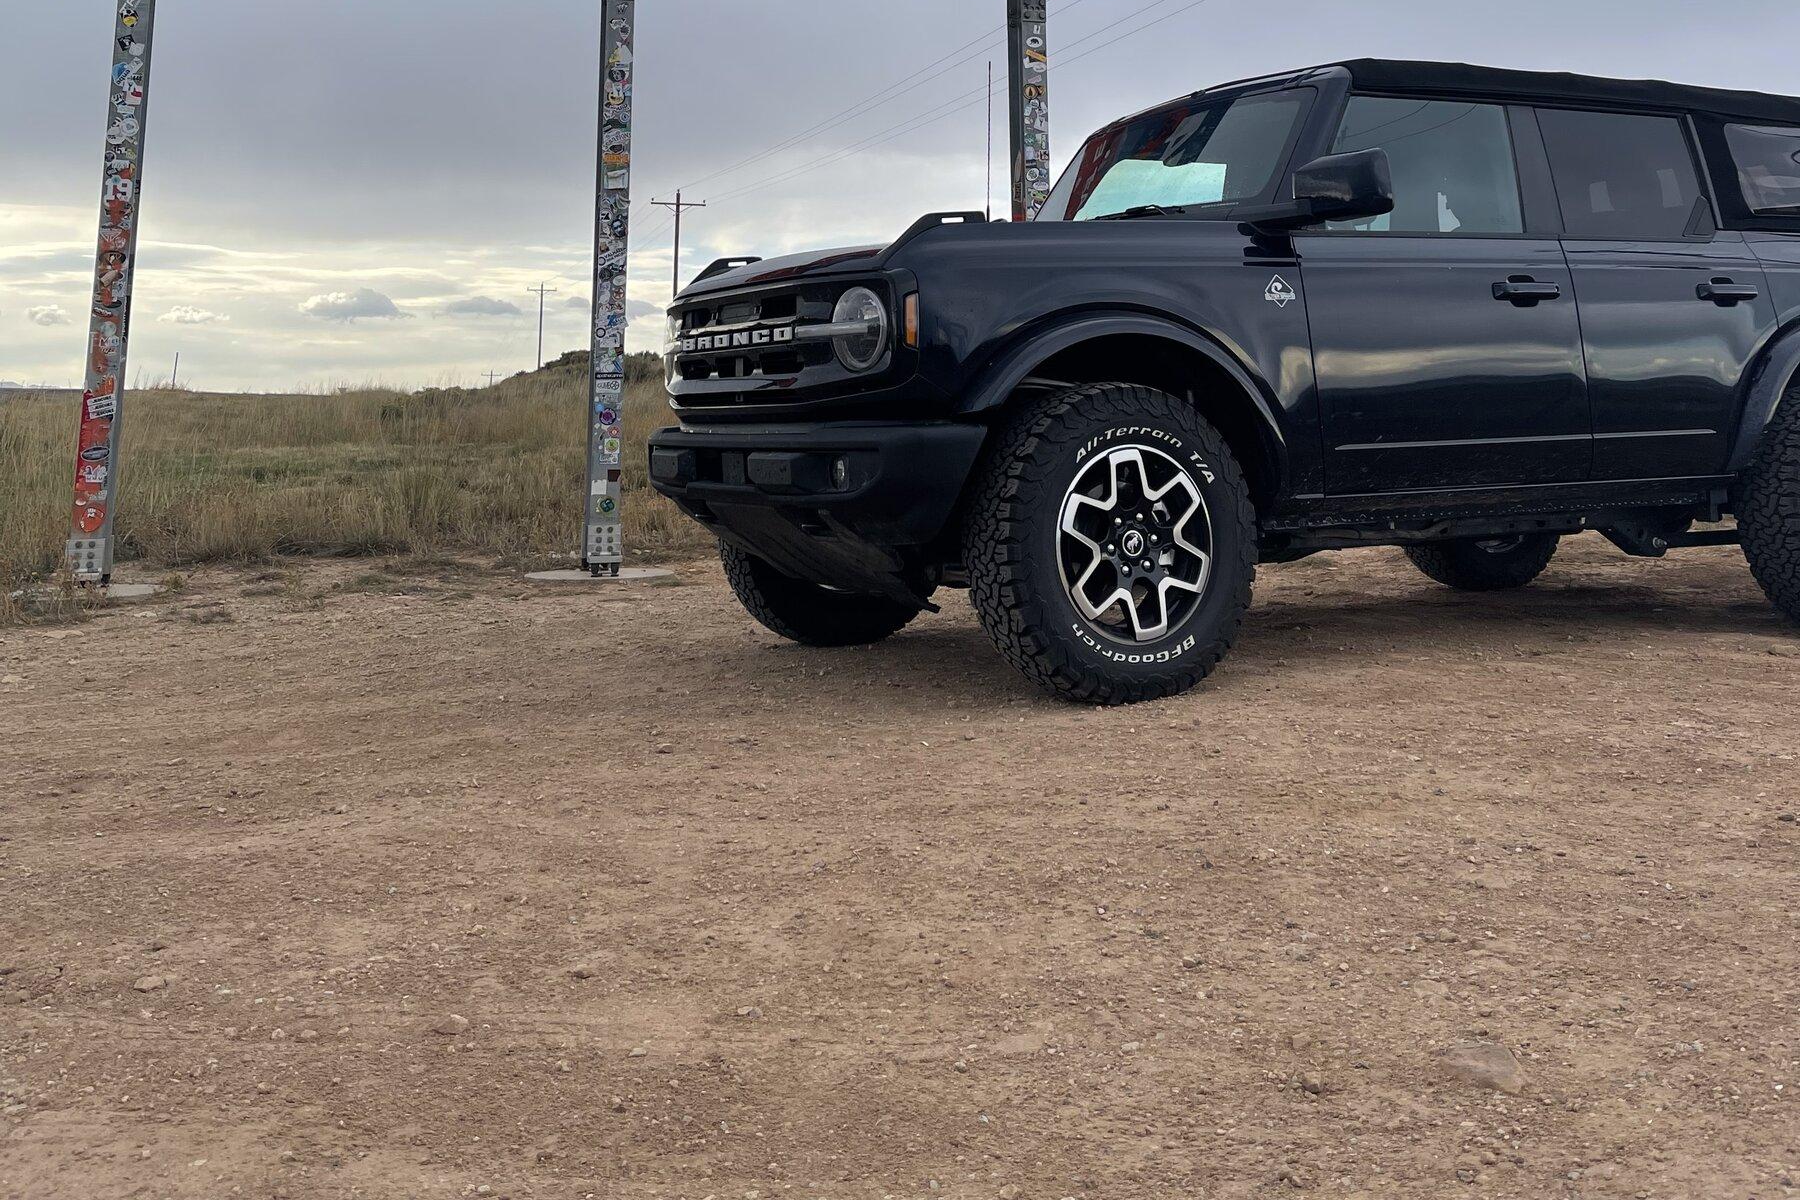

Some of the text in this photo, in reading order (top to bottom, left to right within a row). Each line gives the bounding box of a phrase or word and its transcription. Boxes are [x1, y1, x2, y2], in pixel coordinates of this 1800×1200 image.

[682, 326, 793, 351] BRONCO
[1076, 426, 1215, 484] All-Terrain T/A
[1071, 623, 1196, 663] BFGoodrich
